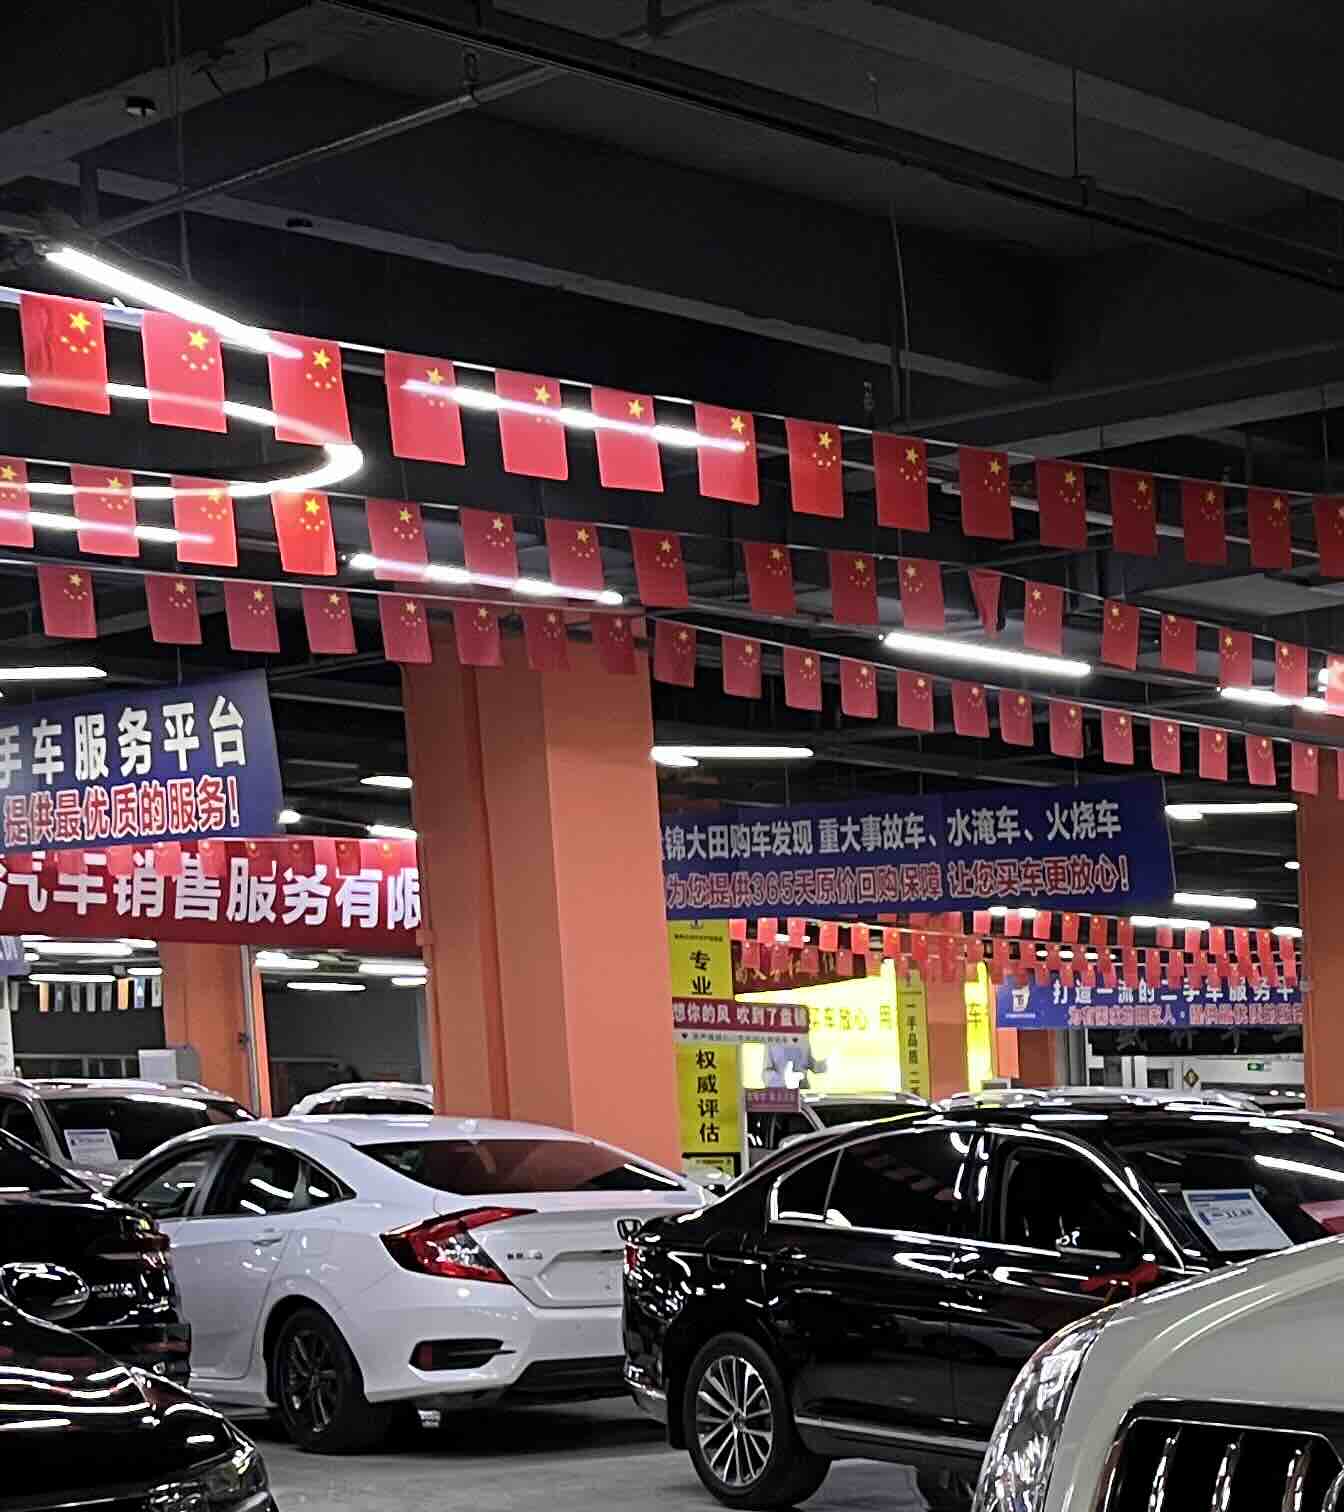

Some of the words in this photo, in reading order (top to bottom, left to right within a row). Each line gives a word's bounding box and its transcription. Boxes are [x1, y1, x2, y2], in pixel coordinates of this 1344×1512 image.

[663, 819, 814, 862] 锦大田购车发现
[696, 1049, 720, 1144] 权威评估
